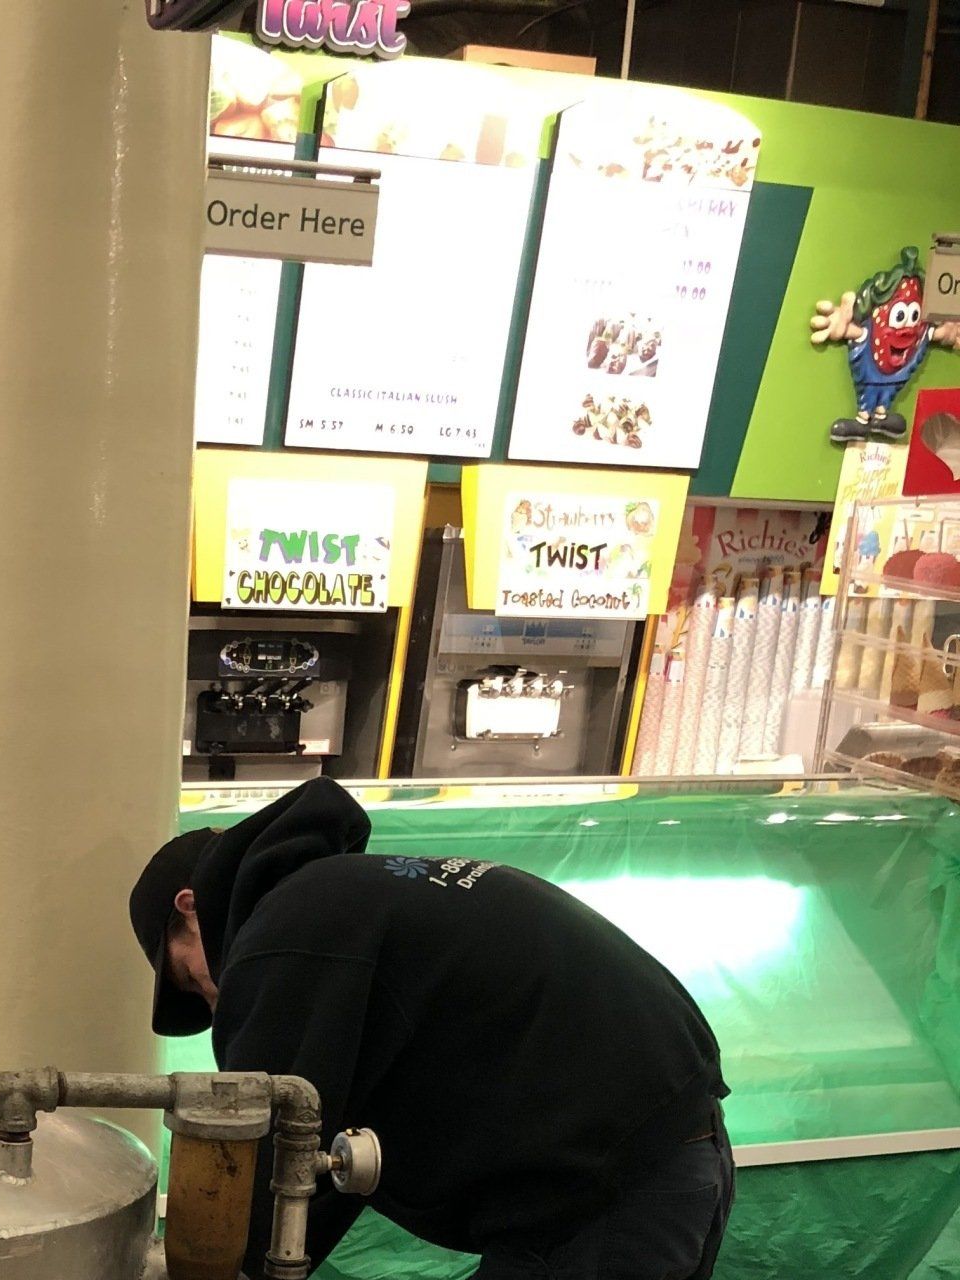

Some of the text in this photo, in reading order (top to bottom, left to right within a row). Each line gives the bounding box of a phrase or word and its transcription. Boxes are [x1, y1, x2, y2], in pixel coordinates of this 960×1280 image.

[207, 200, 365, 237] Order Here
[330, 387, 458, 404] CLASSIC ITALIAN SLUSH
[299, 418, 314, 429] SM
[375, 423, 384, 432] M
[439, 427, 452, 437] LG
[259, 528, 360, 567] TWIST
[715, 519, 809, 559] Richie's
[237, 570, 375, 606] CHOCOLATE
[502, 588, 631, 610] Toasted Coconut
